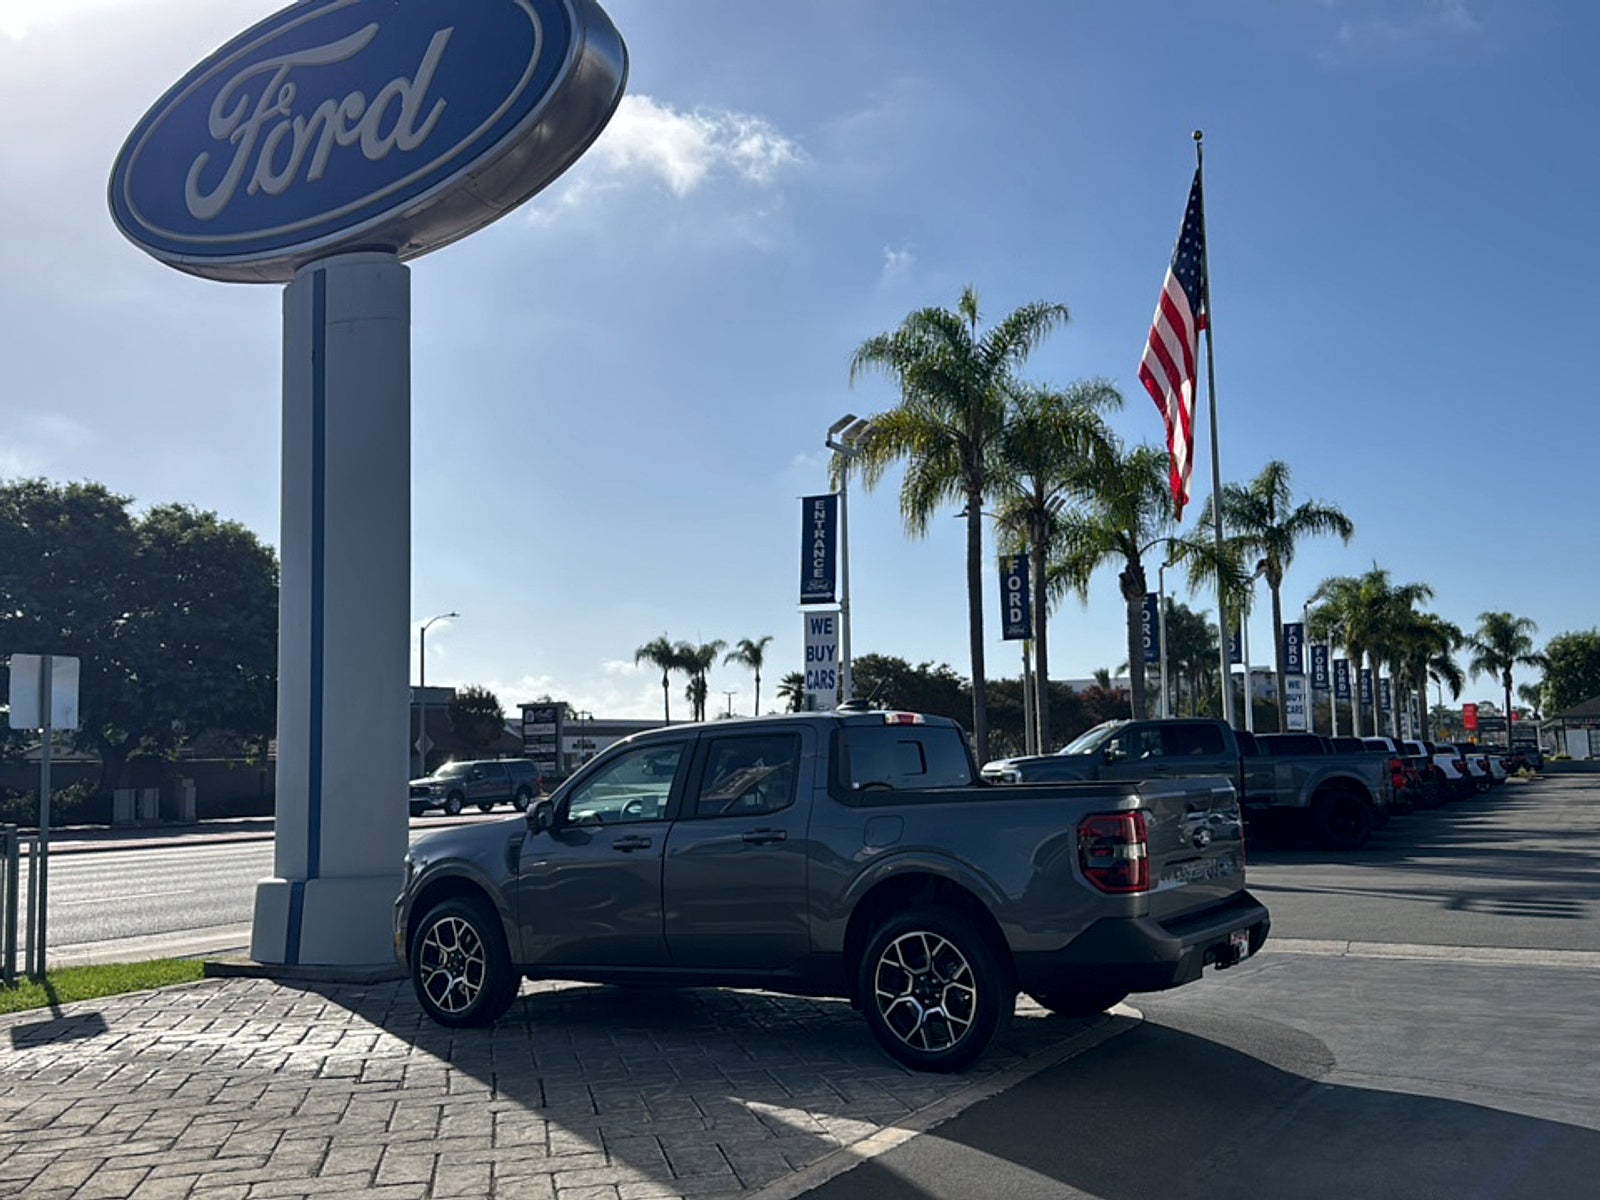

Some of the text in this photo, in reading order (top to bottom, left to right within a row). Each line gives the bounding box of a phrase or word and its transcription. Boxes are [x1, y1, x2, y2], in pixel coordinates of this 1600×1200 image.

[185, 22, 454, 221] Ford
[814, 500, 825, 578] ENTRANCE
[1008, 560, 1022, 623] FORD
[810, 617, 833, 635] WE
[806, 645, 836, 662] BUY
[1288, 626, 1298, 664] FORD
[806, 669, 836, 690] CARS
[1315, 648, 1325, 682] FORD
